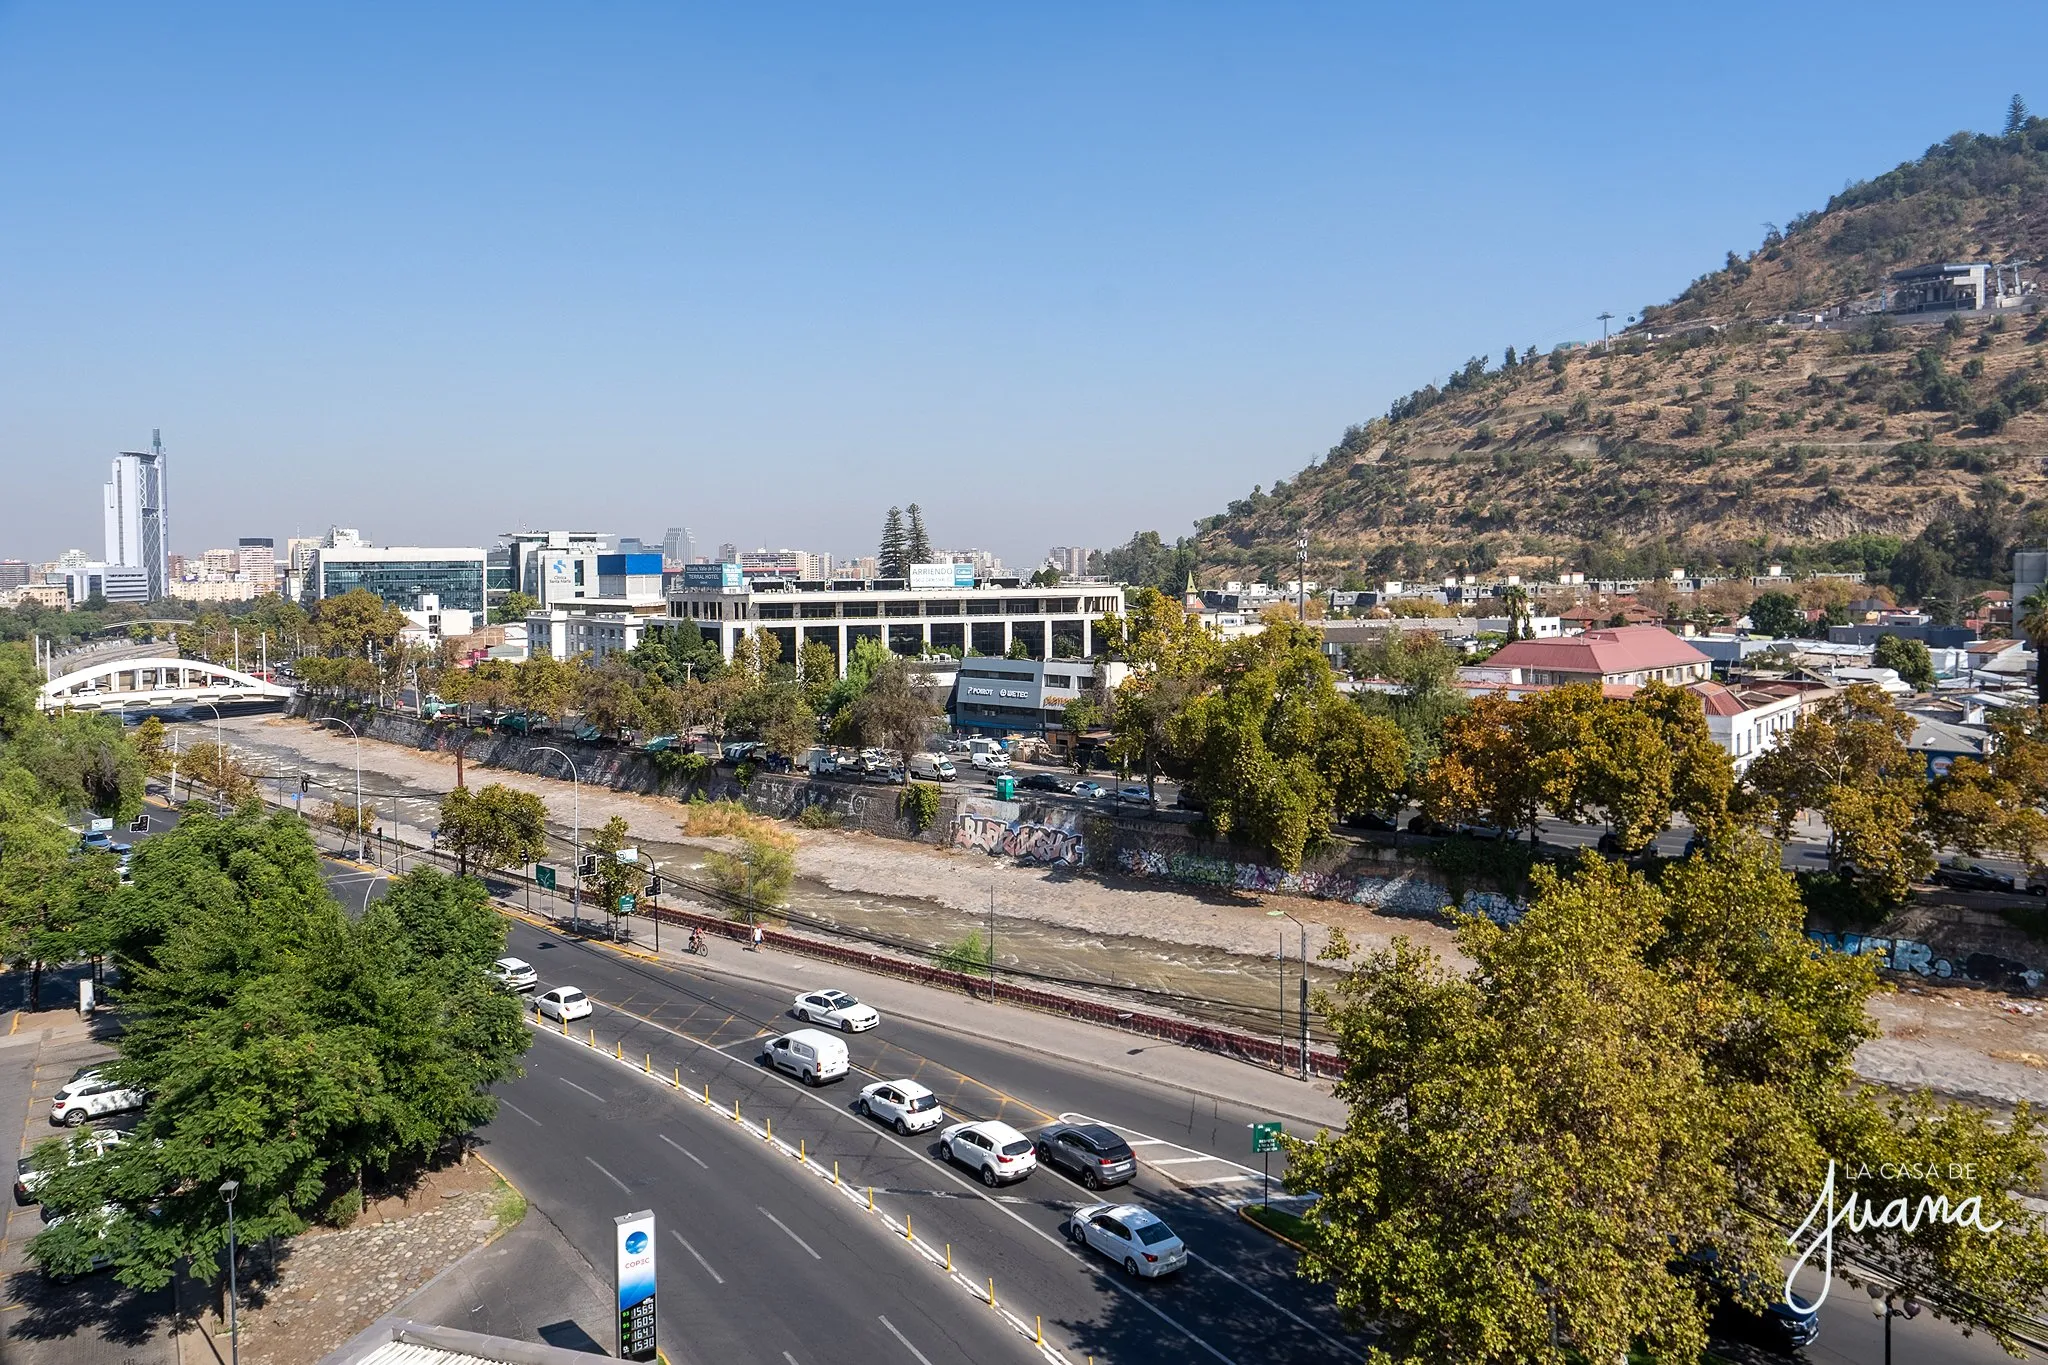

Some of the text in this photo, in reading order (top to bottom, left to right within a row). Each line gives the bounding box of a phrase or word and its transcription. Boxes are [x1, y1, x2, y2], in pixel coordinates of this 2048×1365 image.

[1006, 690, 1029, 699] WETEC
[625, 1257, 650, 1269] COPEC
[633, 1303, 654, 1317] 1569
[633, 1314, 654, 1328] 1605
[634, 1325, 655, 1340] 1647
[634, 1336, 655, 1351] 1530
